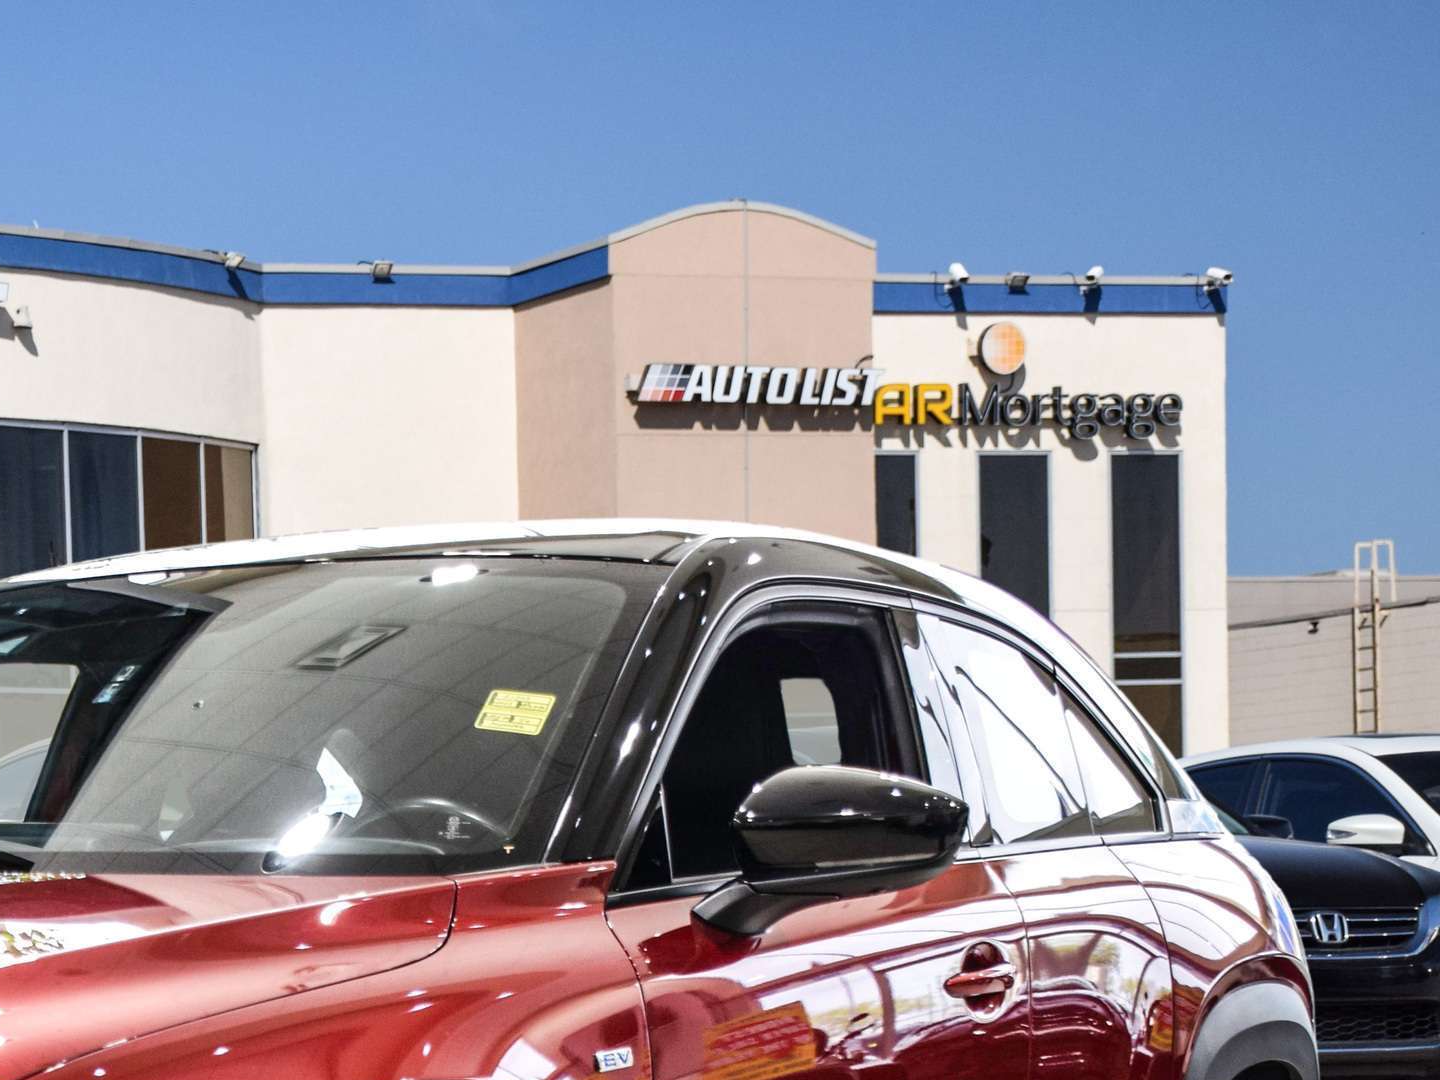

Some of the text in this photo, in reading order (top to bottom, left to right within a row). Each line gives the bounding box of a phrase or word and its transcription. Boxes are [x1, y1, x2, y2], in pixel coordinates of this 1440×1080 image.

[683, 364, 885, 406] AUTO LIST
[874, 383, 1183, 439] AR Mortgage
[603, 1050, 630, 1067] EV
